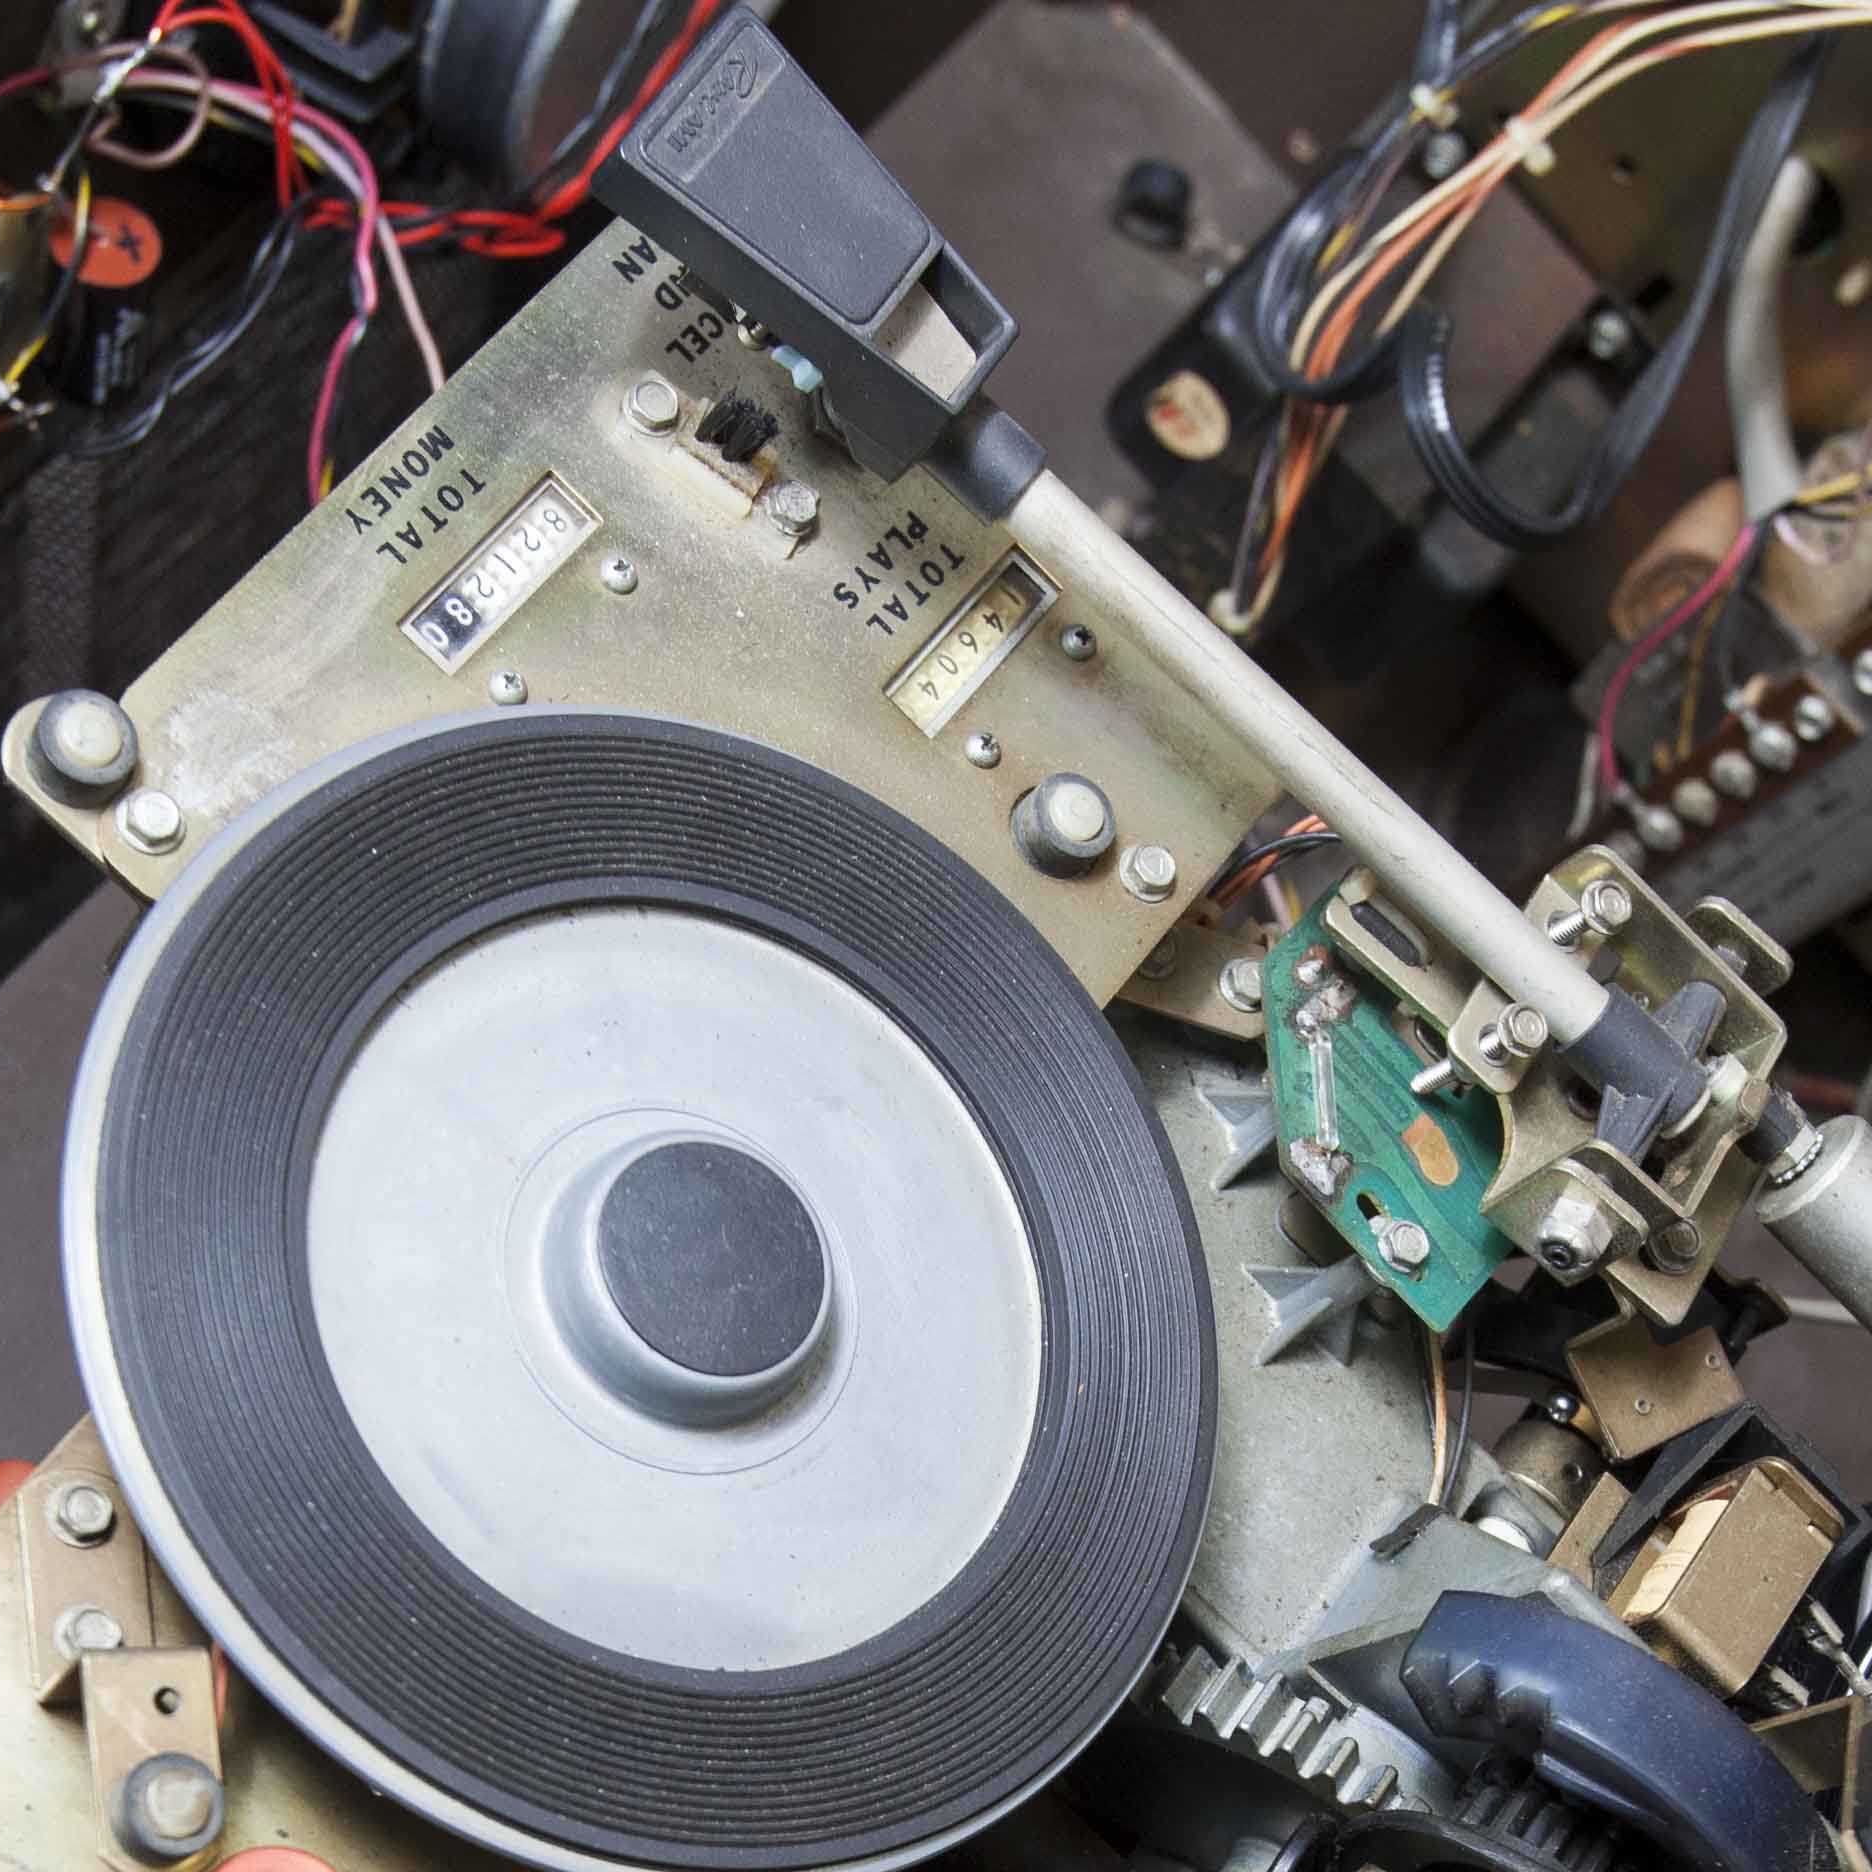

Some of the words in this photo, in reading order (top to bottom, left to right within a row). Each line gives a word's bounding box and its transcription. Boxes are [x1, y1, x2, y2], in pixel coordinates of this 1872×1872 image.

[345, 424, 456, 535] MONEY
[376, 468, 486, 565] TOTAL
[833, 510, 929, 609] PLAYS
[866, 543, 965, 635] TOTAL
